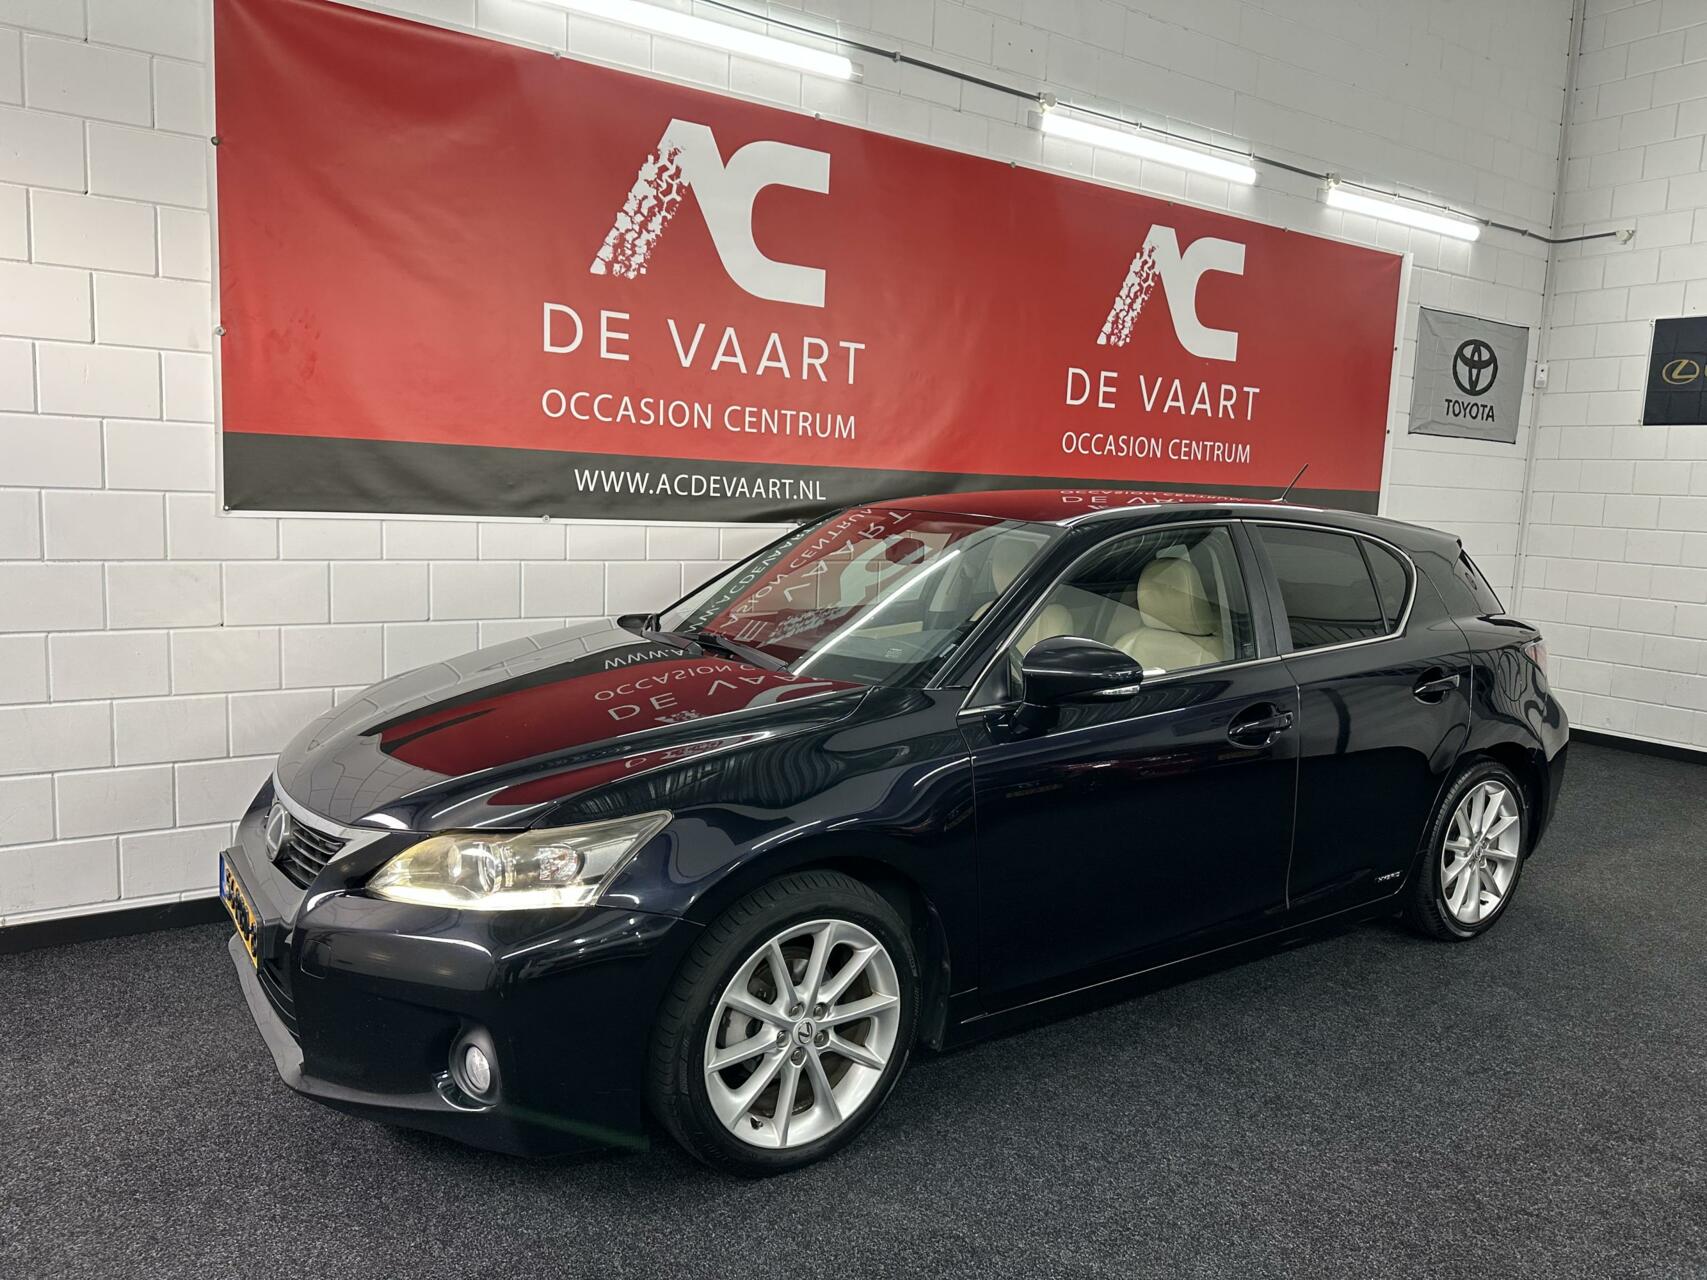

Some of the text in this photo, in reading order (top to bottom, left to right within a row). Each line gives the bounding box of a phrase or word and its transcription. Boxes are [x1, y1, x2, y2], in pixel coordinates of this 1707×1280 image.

[543, 302, 866, 385] DE VAART
[541, 388, 856, 440] OCCASION CENTRUM
[1065, 367, 1260, 421] DE VAART
[1445, 398, 1495, 423] TOYOTA
[1061, 431, 1250, 464] OCCASION CENTRUM
[574, 469, 827, 501] WWW.ACDEVAART.NL
